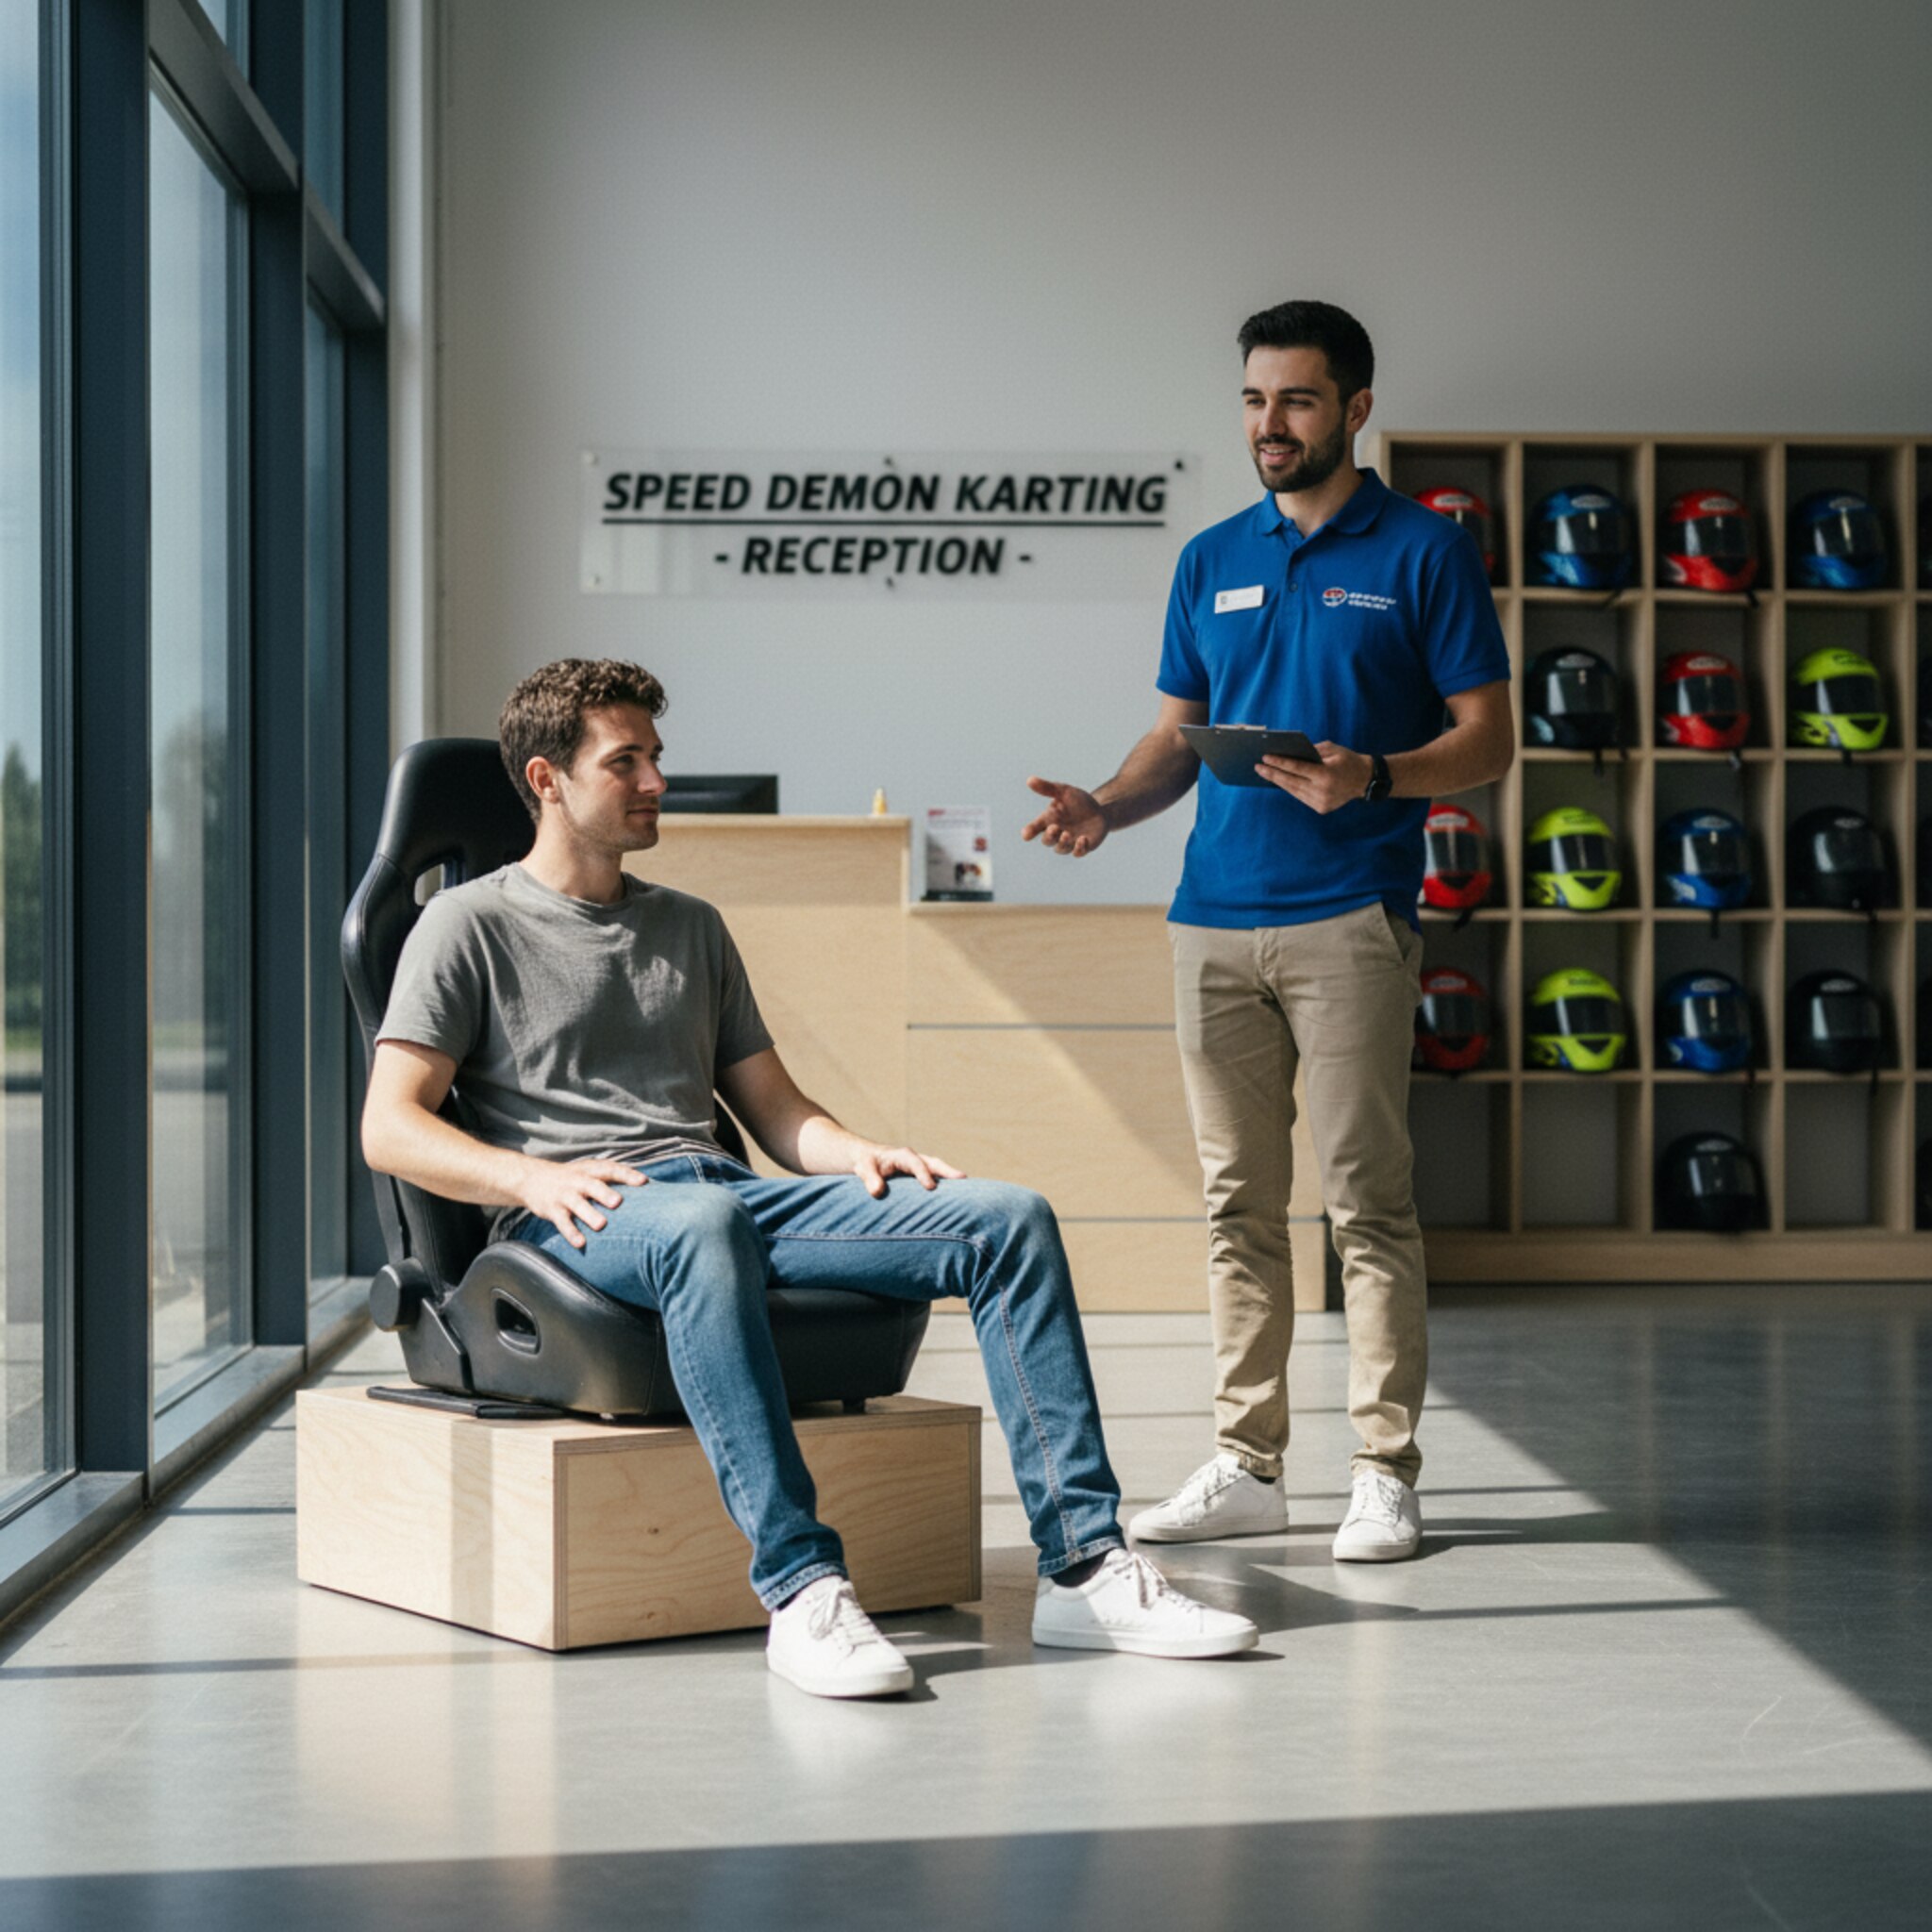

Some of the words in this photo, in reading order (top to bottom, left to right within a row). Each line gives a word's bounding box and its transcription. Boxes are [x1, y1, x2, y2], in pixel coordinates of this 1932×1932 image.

[603, 472, 752, 513] SPEED
[765, 473, 941, 513] DEMON
[955, 474, 1170, 515] KARTING
[741, 536, 1007, 576] RECEPTION
